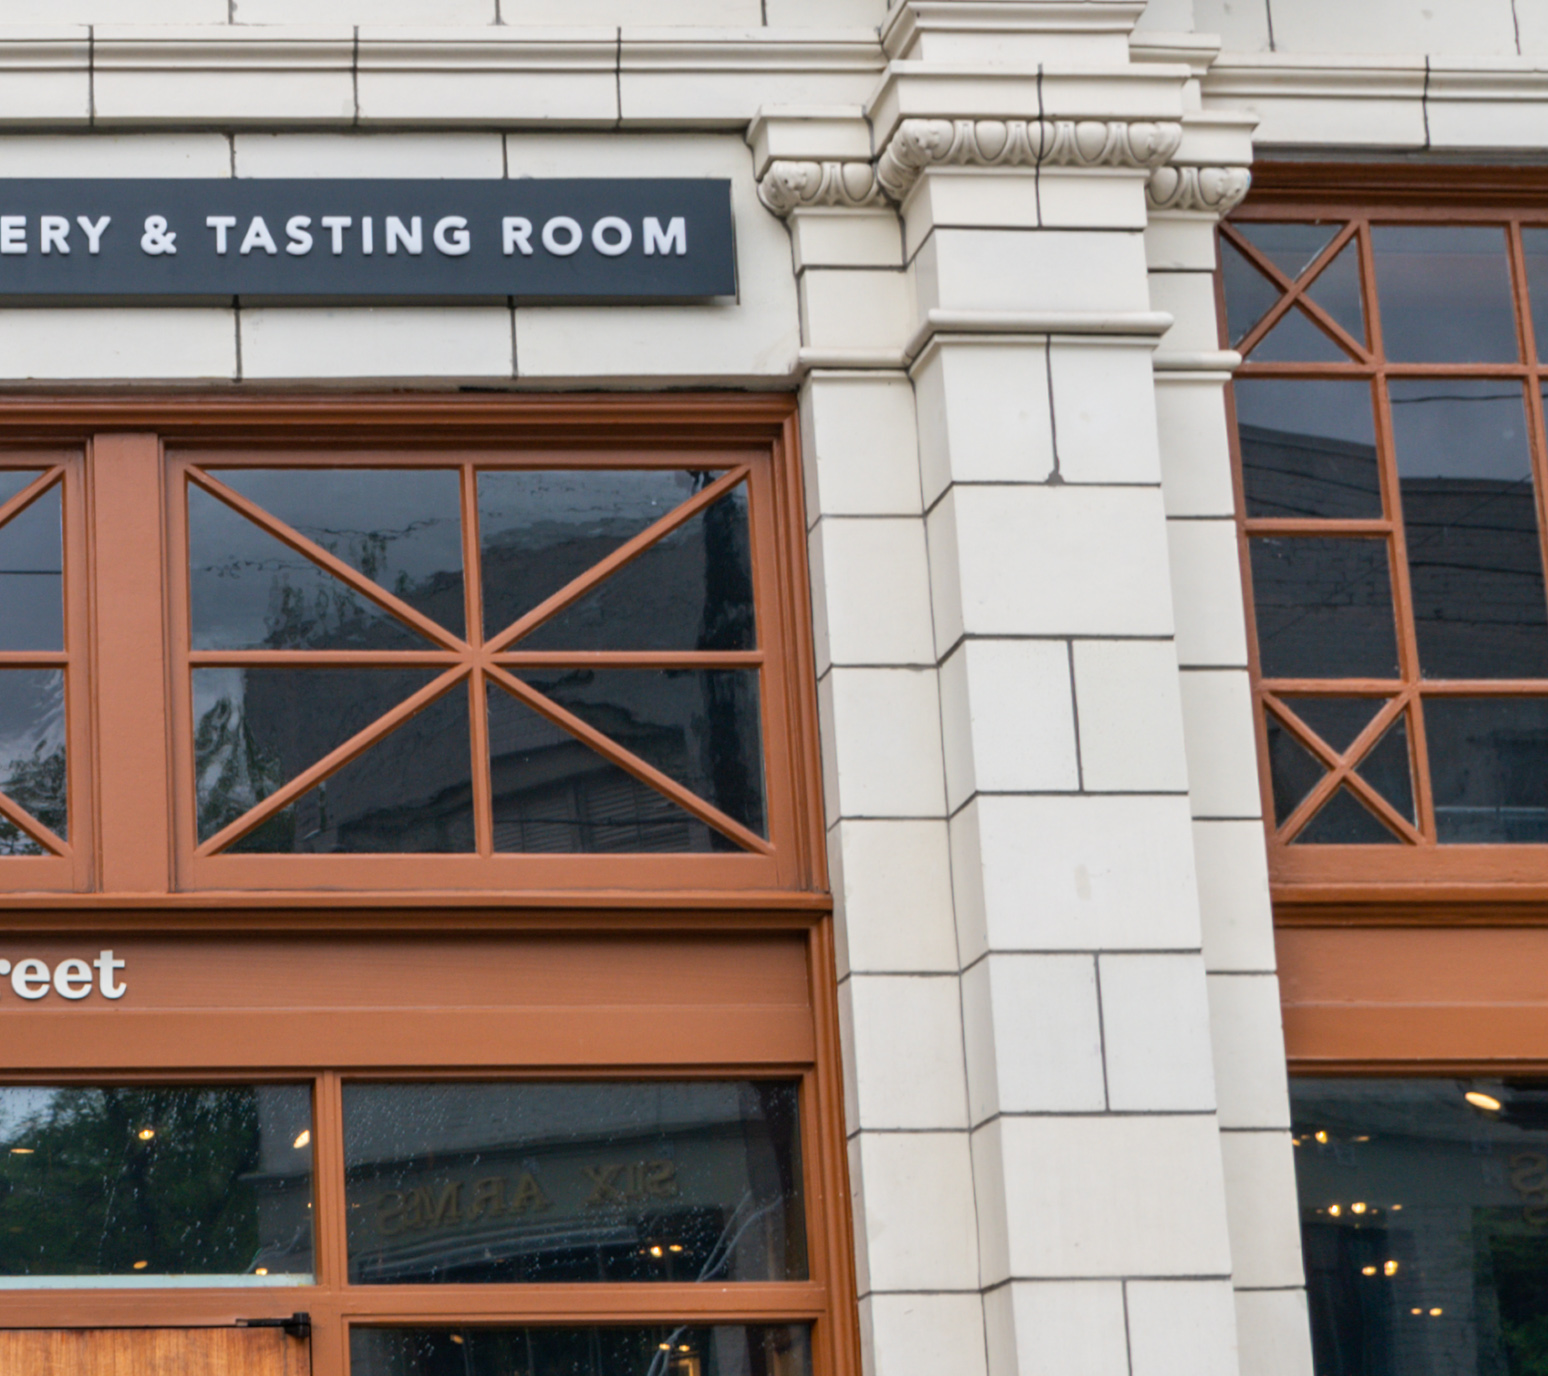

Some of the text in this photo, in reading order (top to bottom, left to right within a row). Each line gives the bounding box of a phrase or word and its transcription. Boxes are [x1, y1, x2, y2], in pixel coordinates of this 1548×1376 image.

[140, 214, 177, 255] &
[206, 215, 471, 256] TASTING
[502, 216, 688, 256] ROOM
